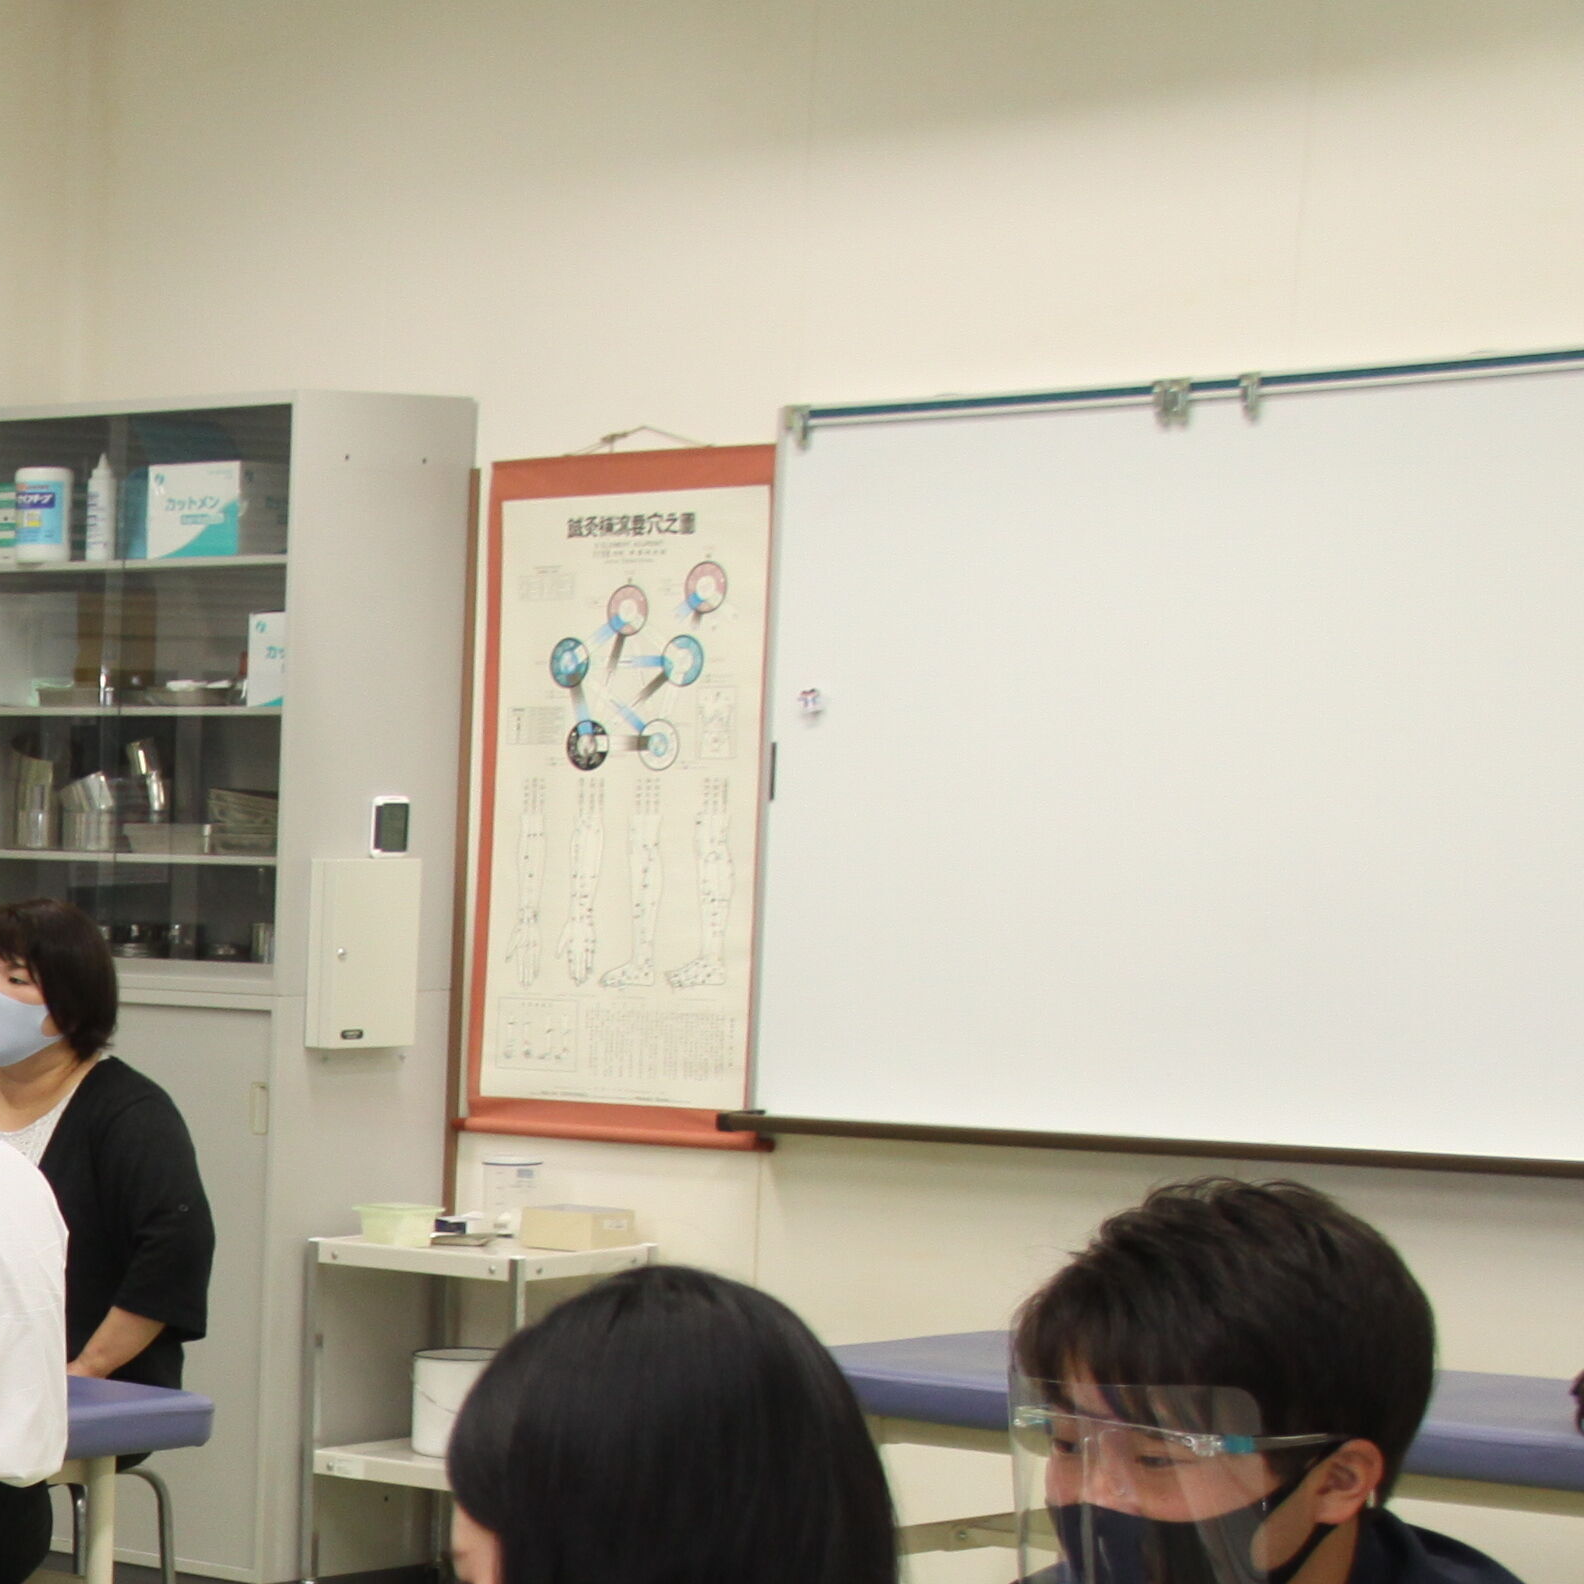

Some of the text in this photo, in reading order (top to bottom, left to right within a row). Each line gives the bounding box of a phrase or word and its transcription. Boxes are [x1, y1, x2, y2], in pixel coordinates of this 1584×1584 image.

[165, 496, 220, 511] カットメン
